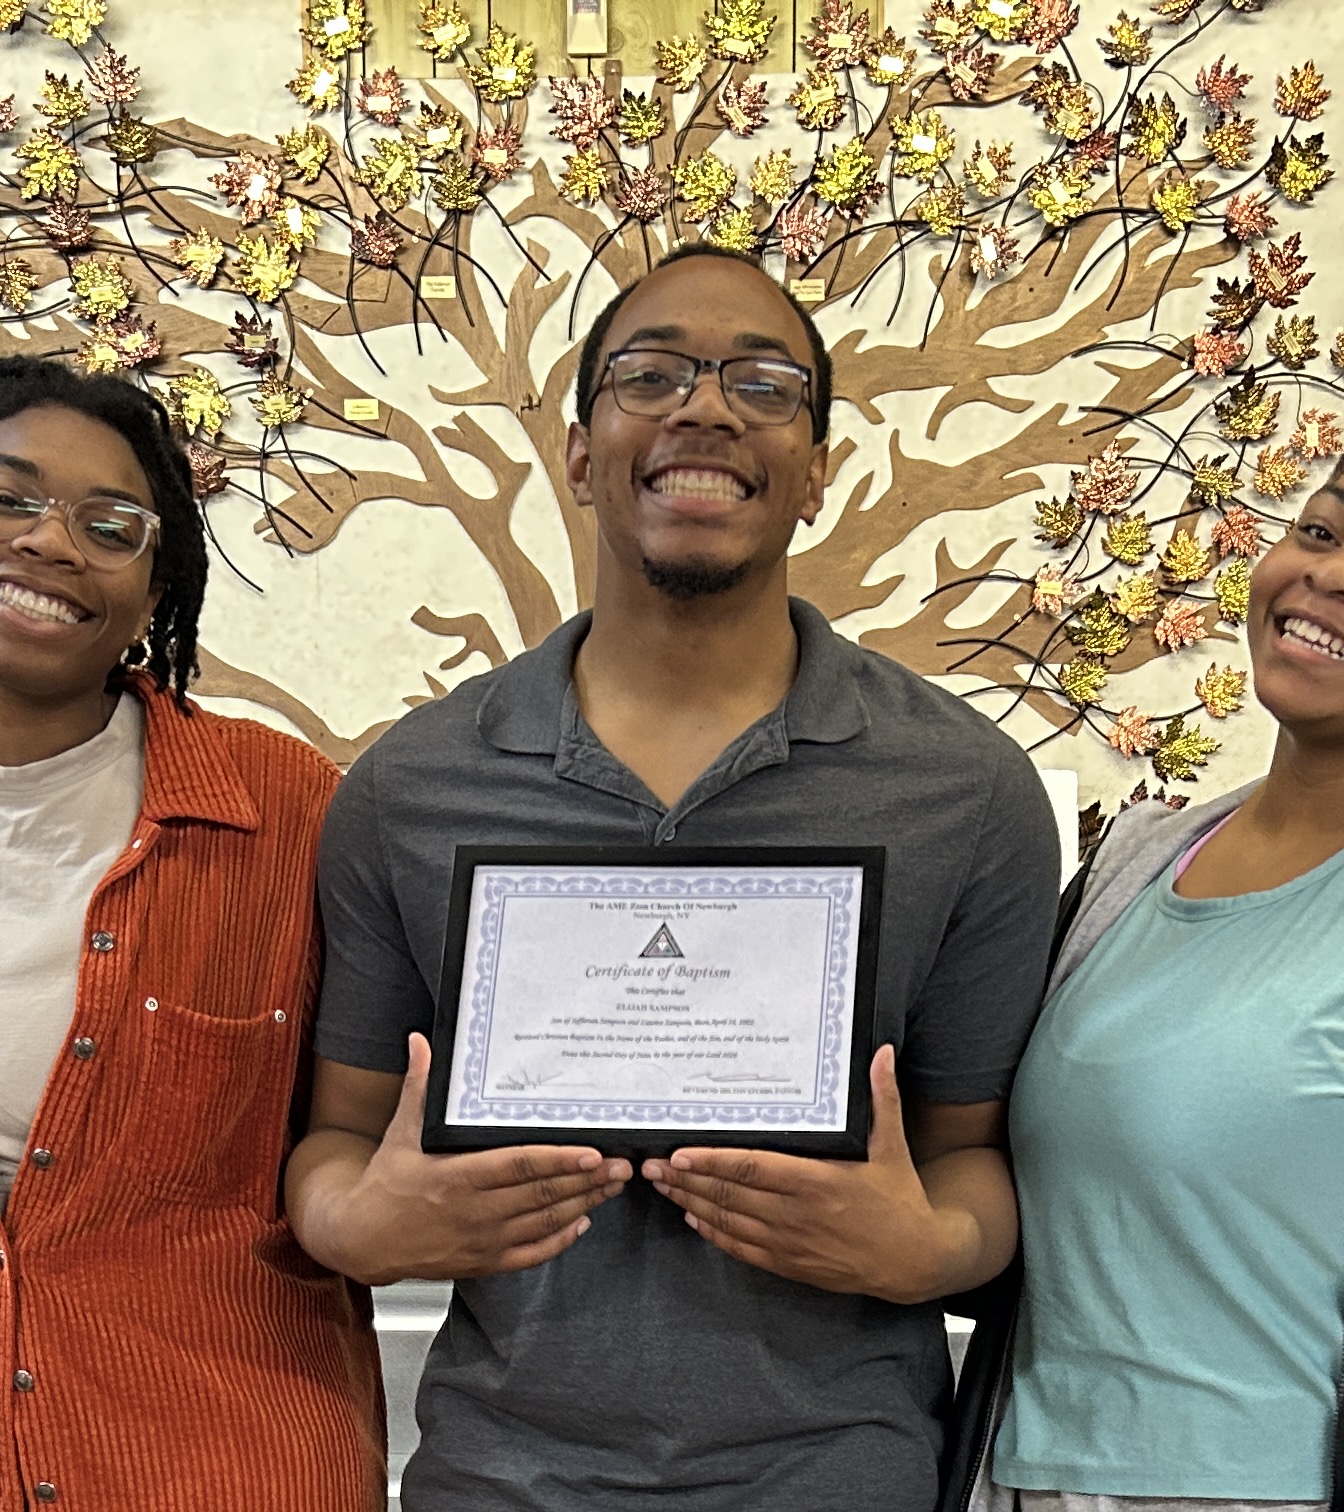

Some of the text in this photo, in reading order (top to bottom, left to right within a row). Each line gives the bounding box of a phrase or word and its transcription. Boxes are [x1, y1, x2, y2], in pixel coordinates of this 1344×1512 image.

[590, 902, 604, 910] The
[606, 902, 627, 910] AME
[650, 902, 681, 911] Church
[585, 963, 731, 982] Certificate of Baptism
